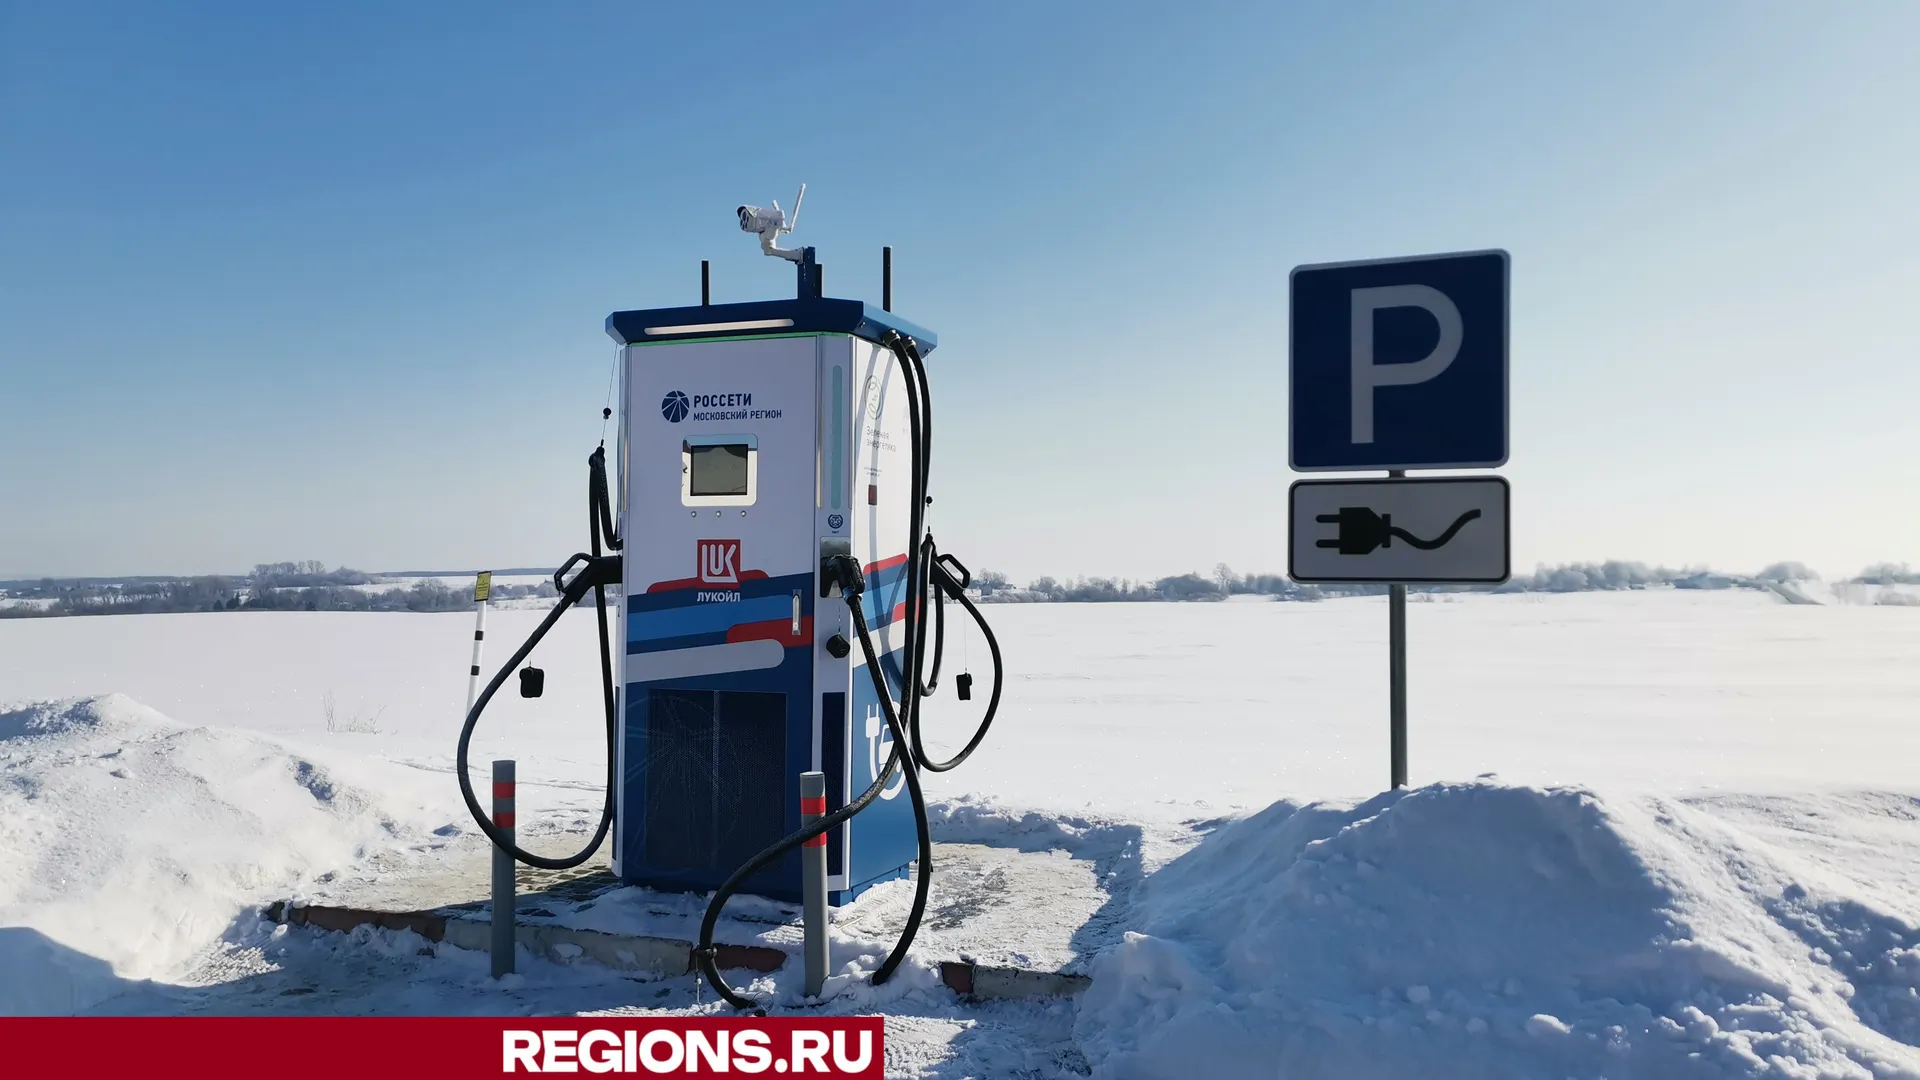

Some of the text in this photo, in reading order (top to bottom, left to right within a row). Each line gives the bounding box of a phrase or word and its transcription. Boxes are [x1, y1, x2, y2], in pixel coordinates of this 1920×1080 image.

[1351, 284, 1464, 444] P
[693, 393, 752, 407] РОССЕТИ
[693, 409, 782, 421] МОСКОВСКИЙ РЕГИОН
[696, 590, 741, 602] ЛУКОЙЛ
